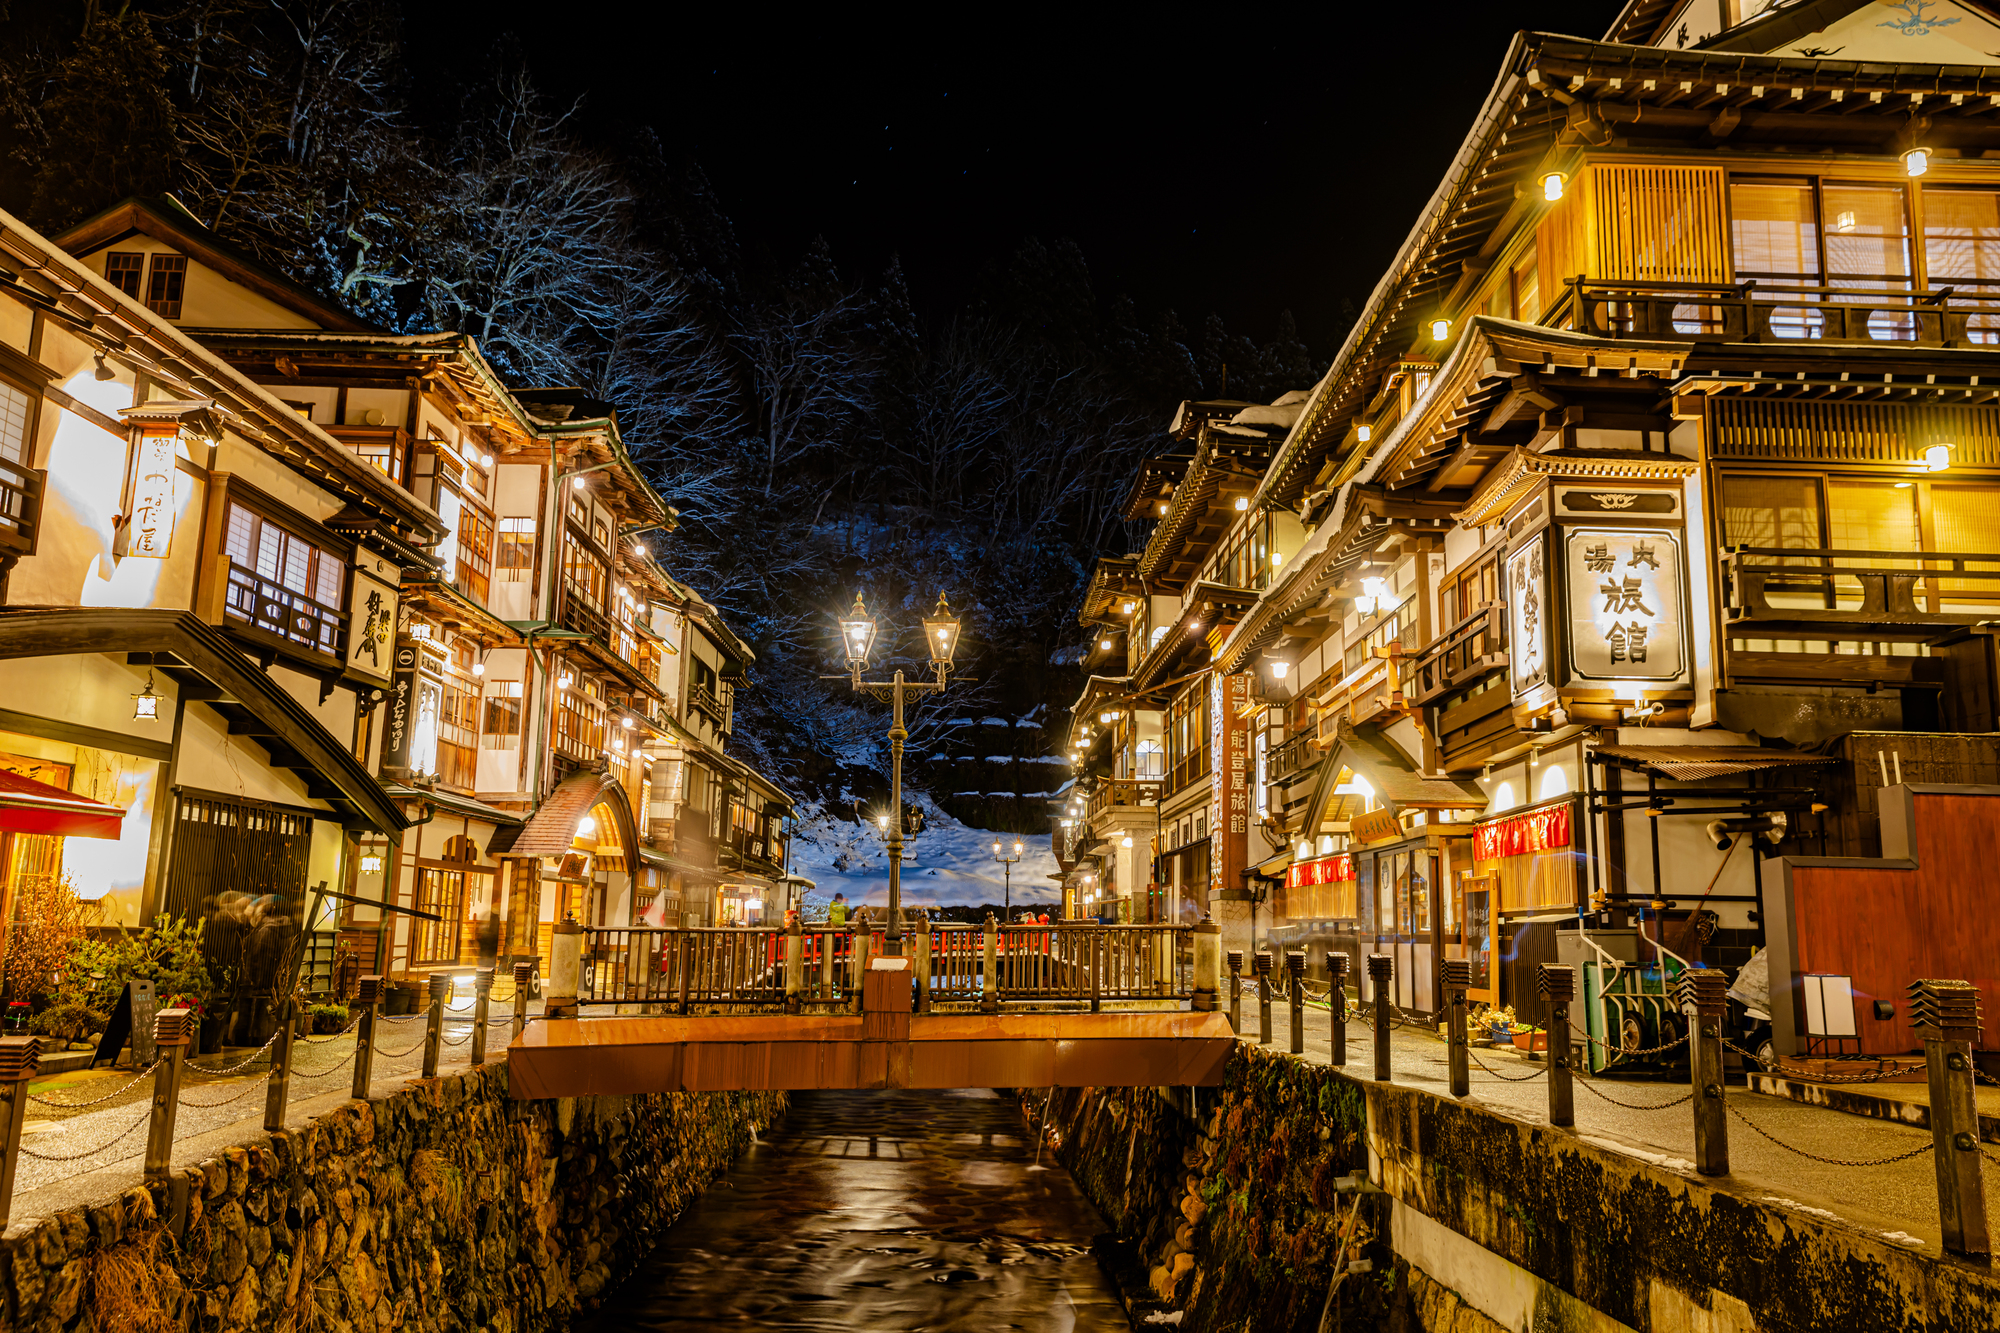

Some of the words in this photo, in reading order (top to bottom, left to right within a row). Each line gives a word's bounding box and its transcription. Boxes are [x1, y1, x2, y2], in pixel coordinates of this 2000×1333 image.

[1599, 573, 1656, 666] 旅館
[1230, 729, 1246, 834] 能登屋旅館
